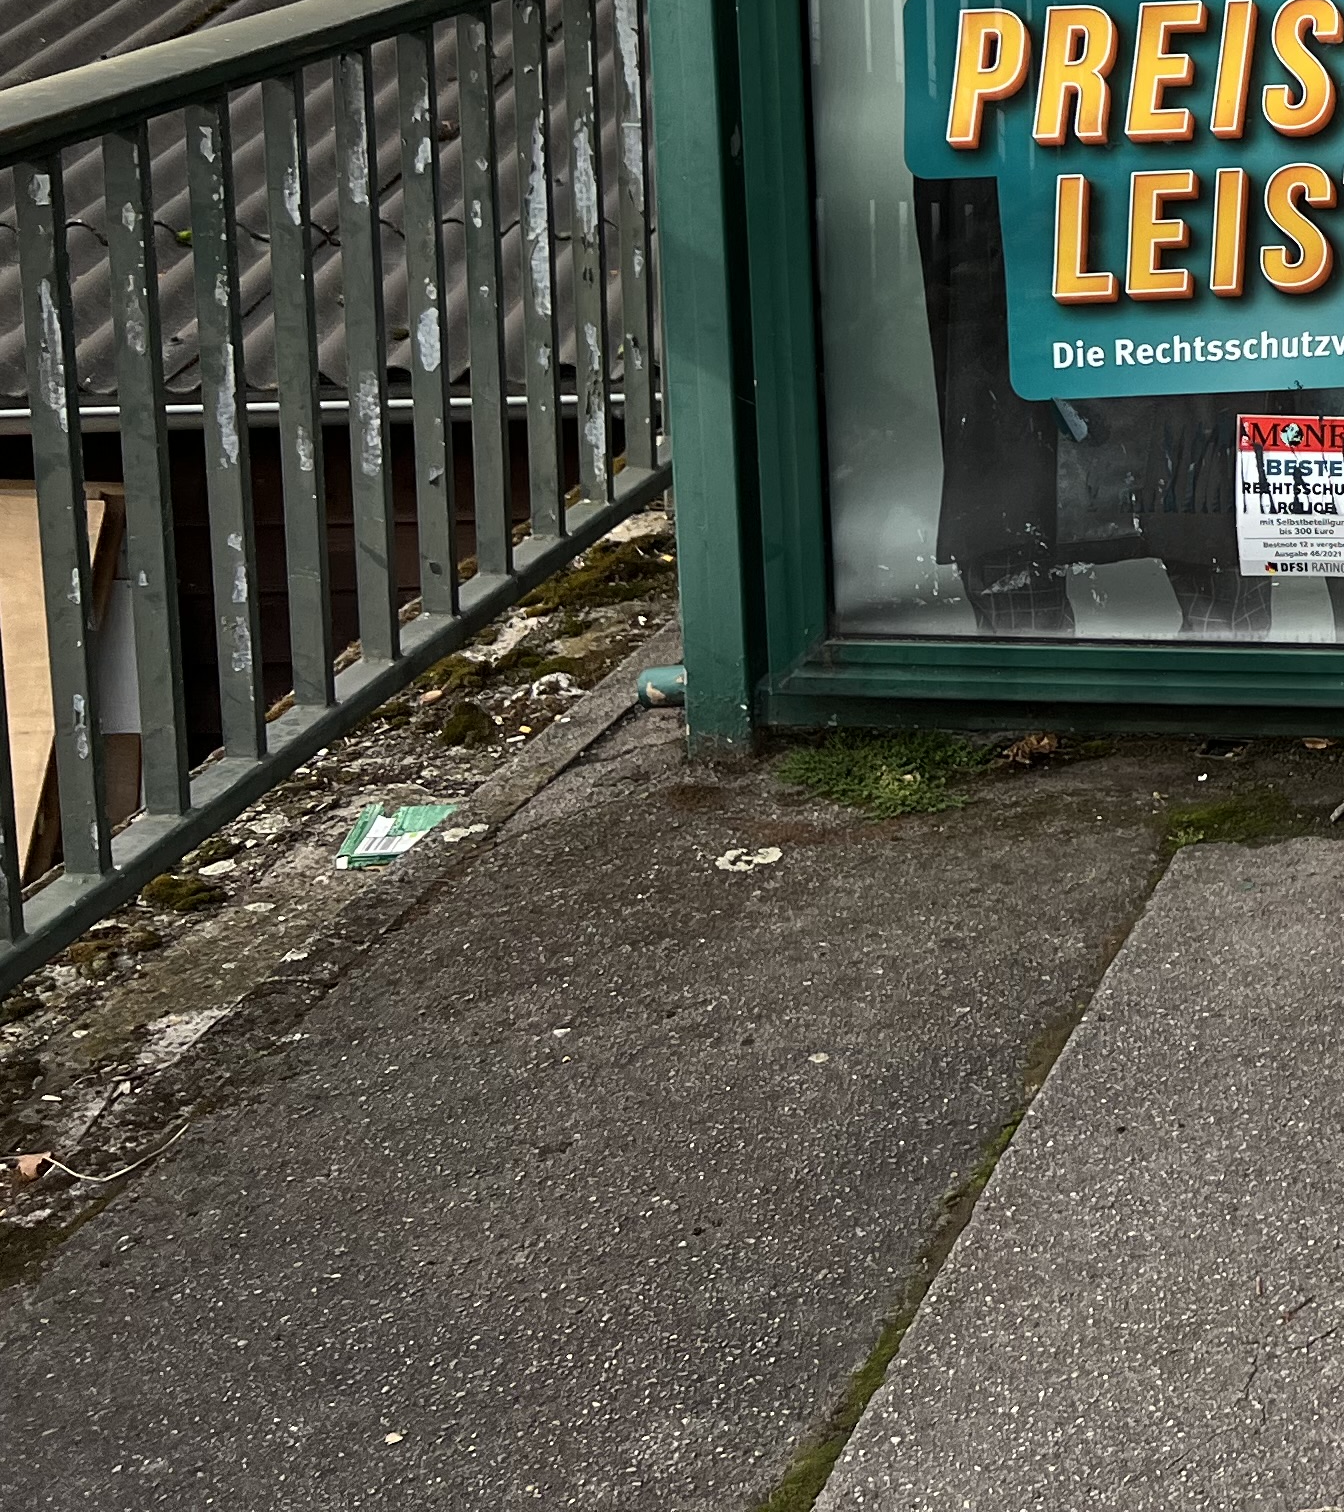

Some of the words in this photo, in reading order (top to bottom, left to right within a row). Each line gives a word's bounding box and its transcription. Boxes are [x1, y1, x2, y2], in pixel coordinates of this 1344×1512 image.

[1052, 340, 1105, 370] Die
[1266, 459, 1343, 477] BESTE
[1275, 550, 1308, 558] Ausgabe
[1280, 562, 1308, 573] DFSI
